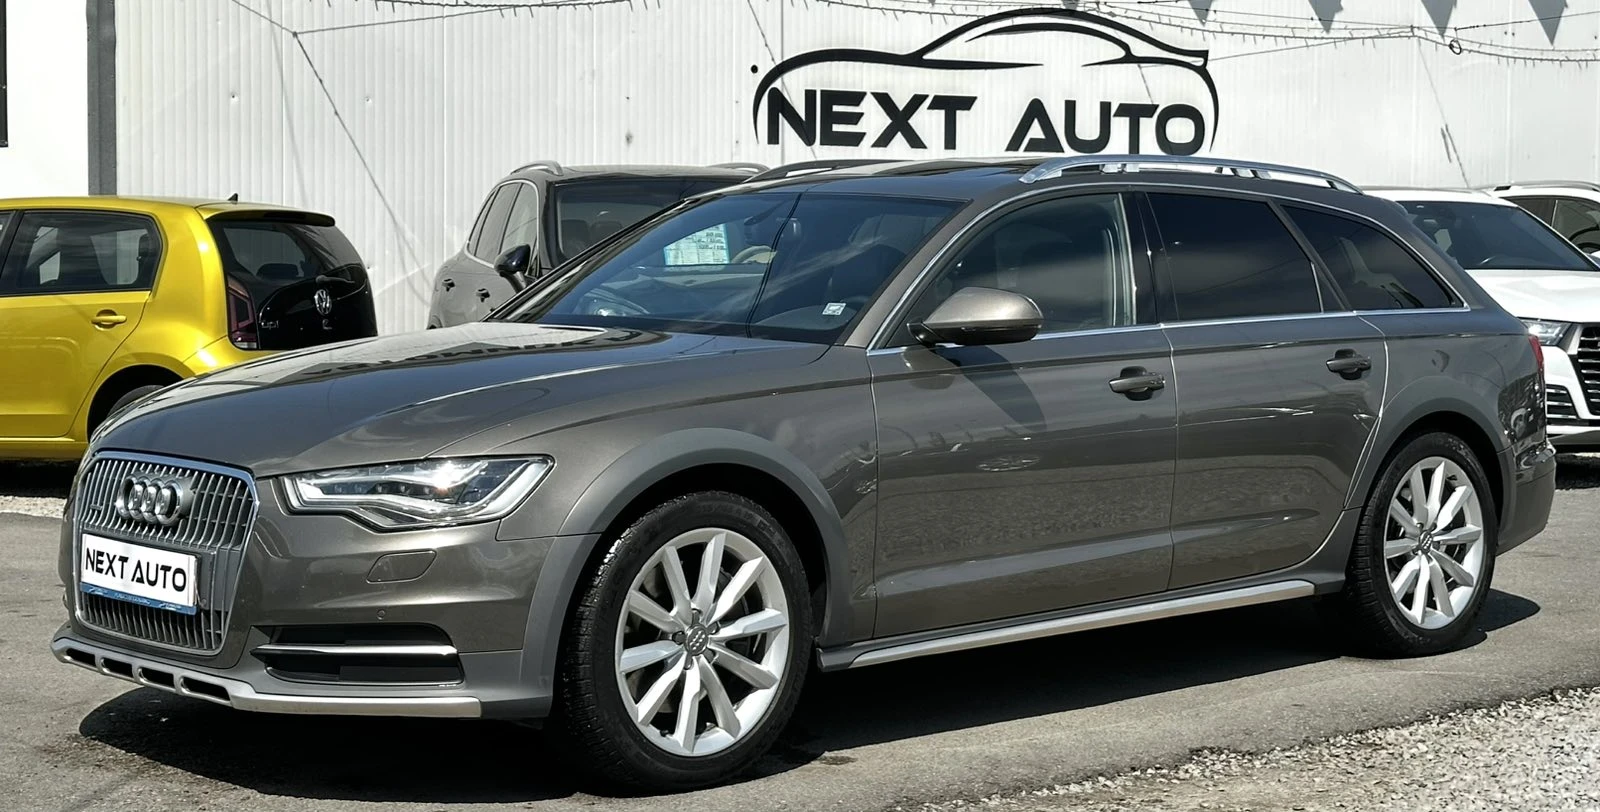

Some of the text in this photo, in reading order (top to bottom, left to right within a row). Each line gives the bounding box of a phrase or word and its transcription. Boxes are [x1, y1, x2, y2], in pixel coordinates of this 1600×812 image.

[767, 87, 1206, 157] NEXT AUTO
[85, 547, 187, 592] NEXT AUTO
